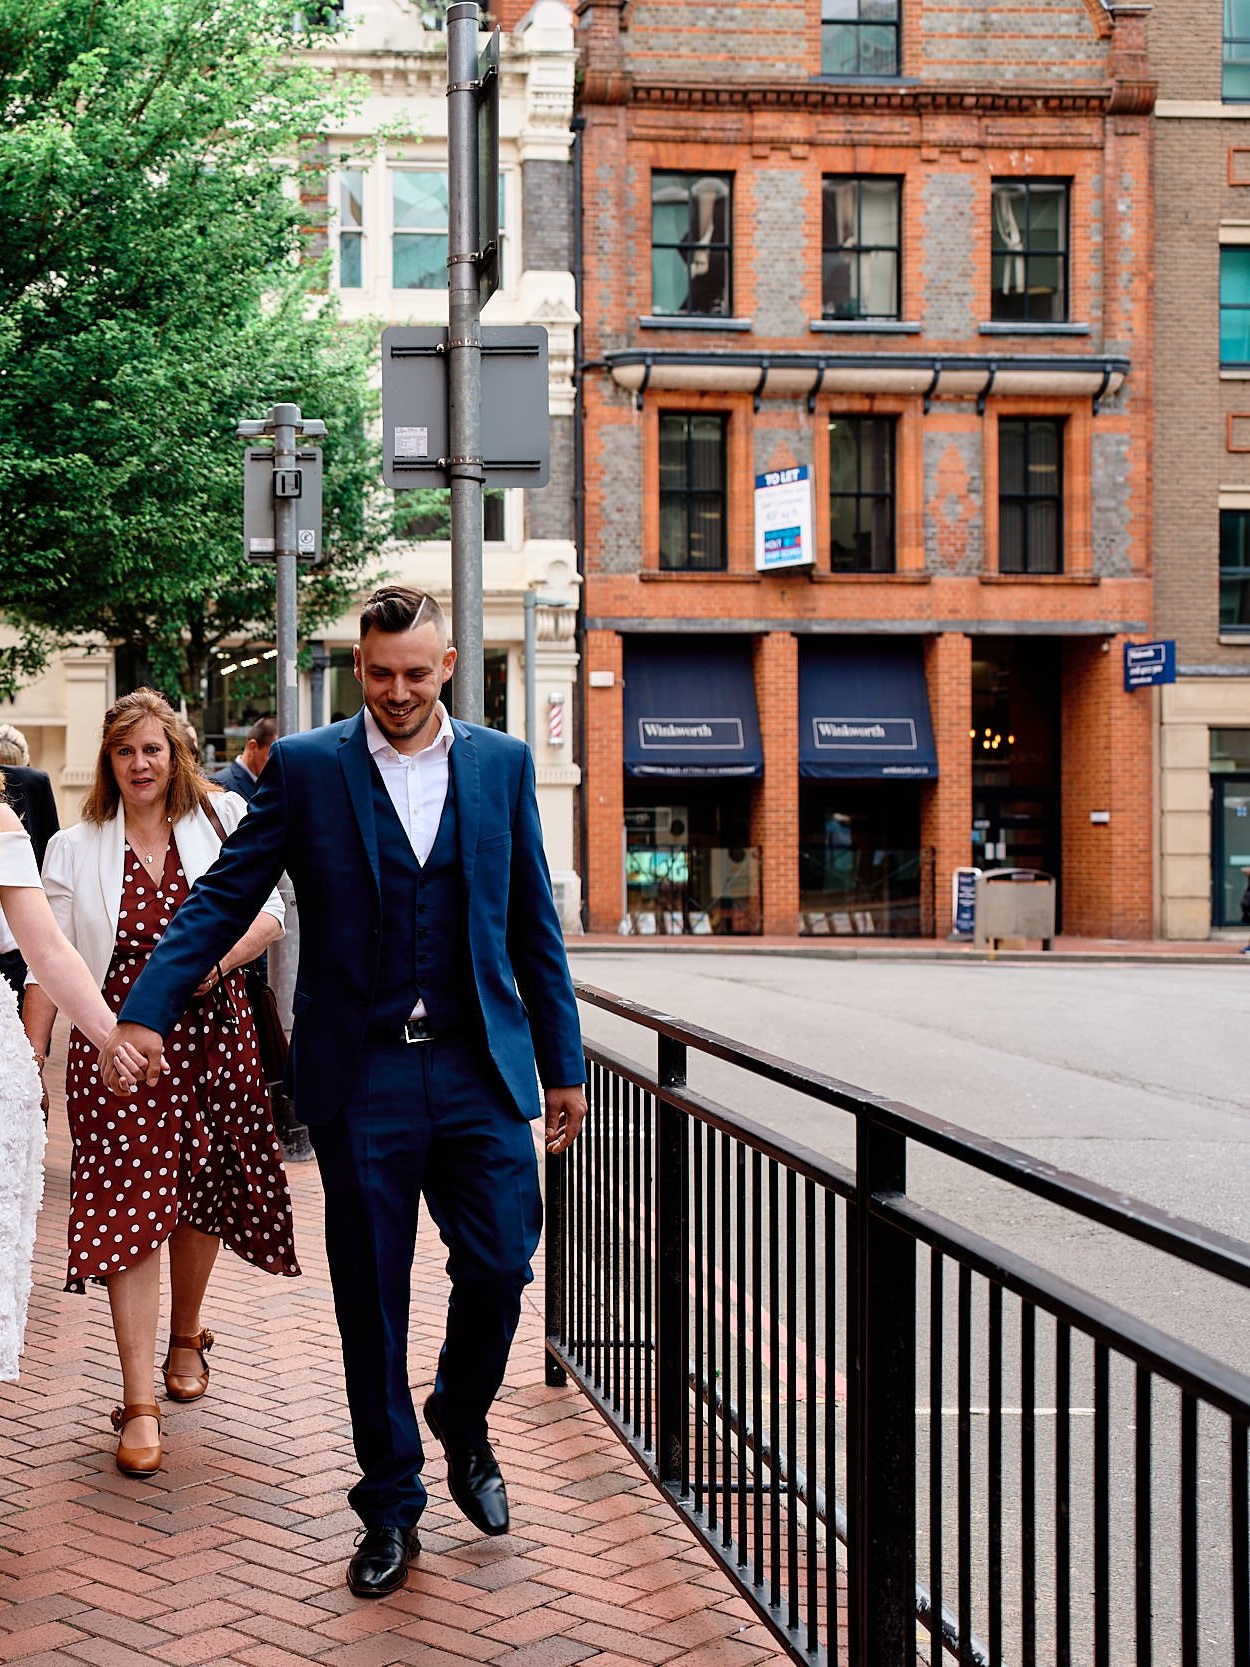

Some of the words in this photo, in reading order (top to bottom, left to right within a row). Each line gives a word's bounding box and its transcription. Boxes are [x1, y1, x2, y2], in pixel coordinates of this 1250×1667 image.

[764, 472, 780, 487] TO
[780, 468, 800, 484] LET
[644, 723, 712, 737] Winkworth
[818, 723, 886, 738] Winkworth
